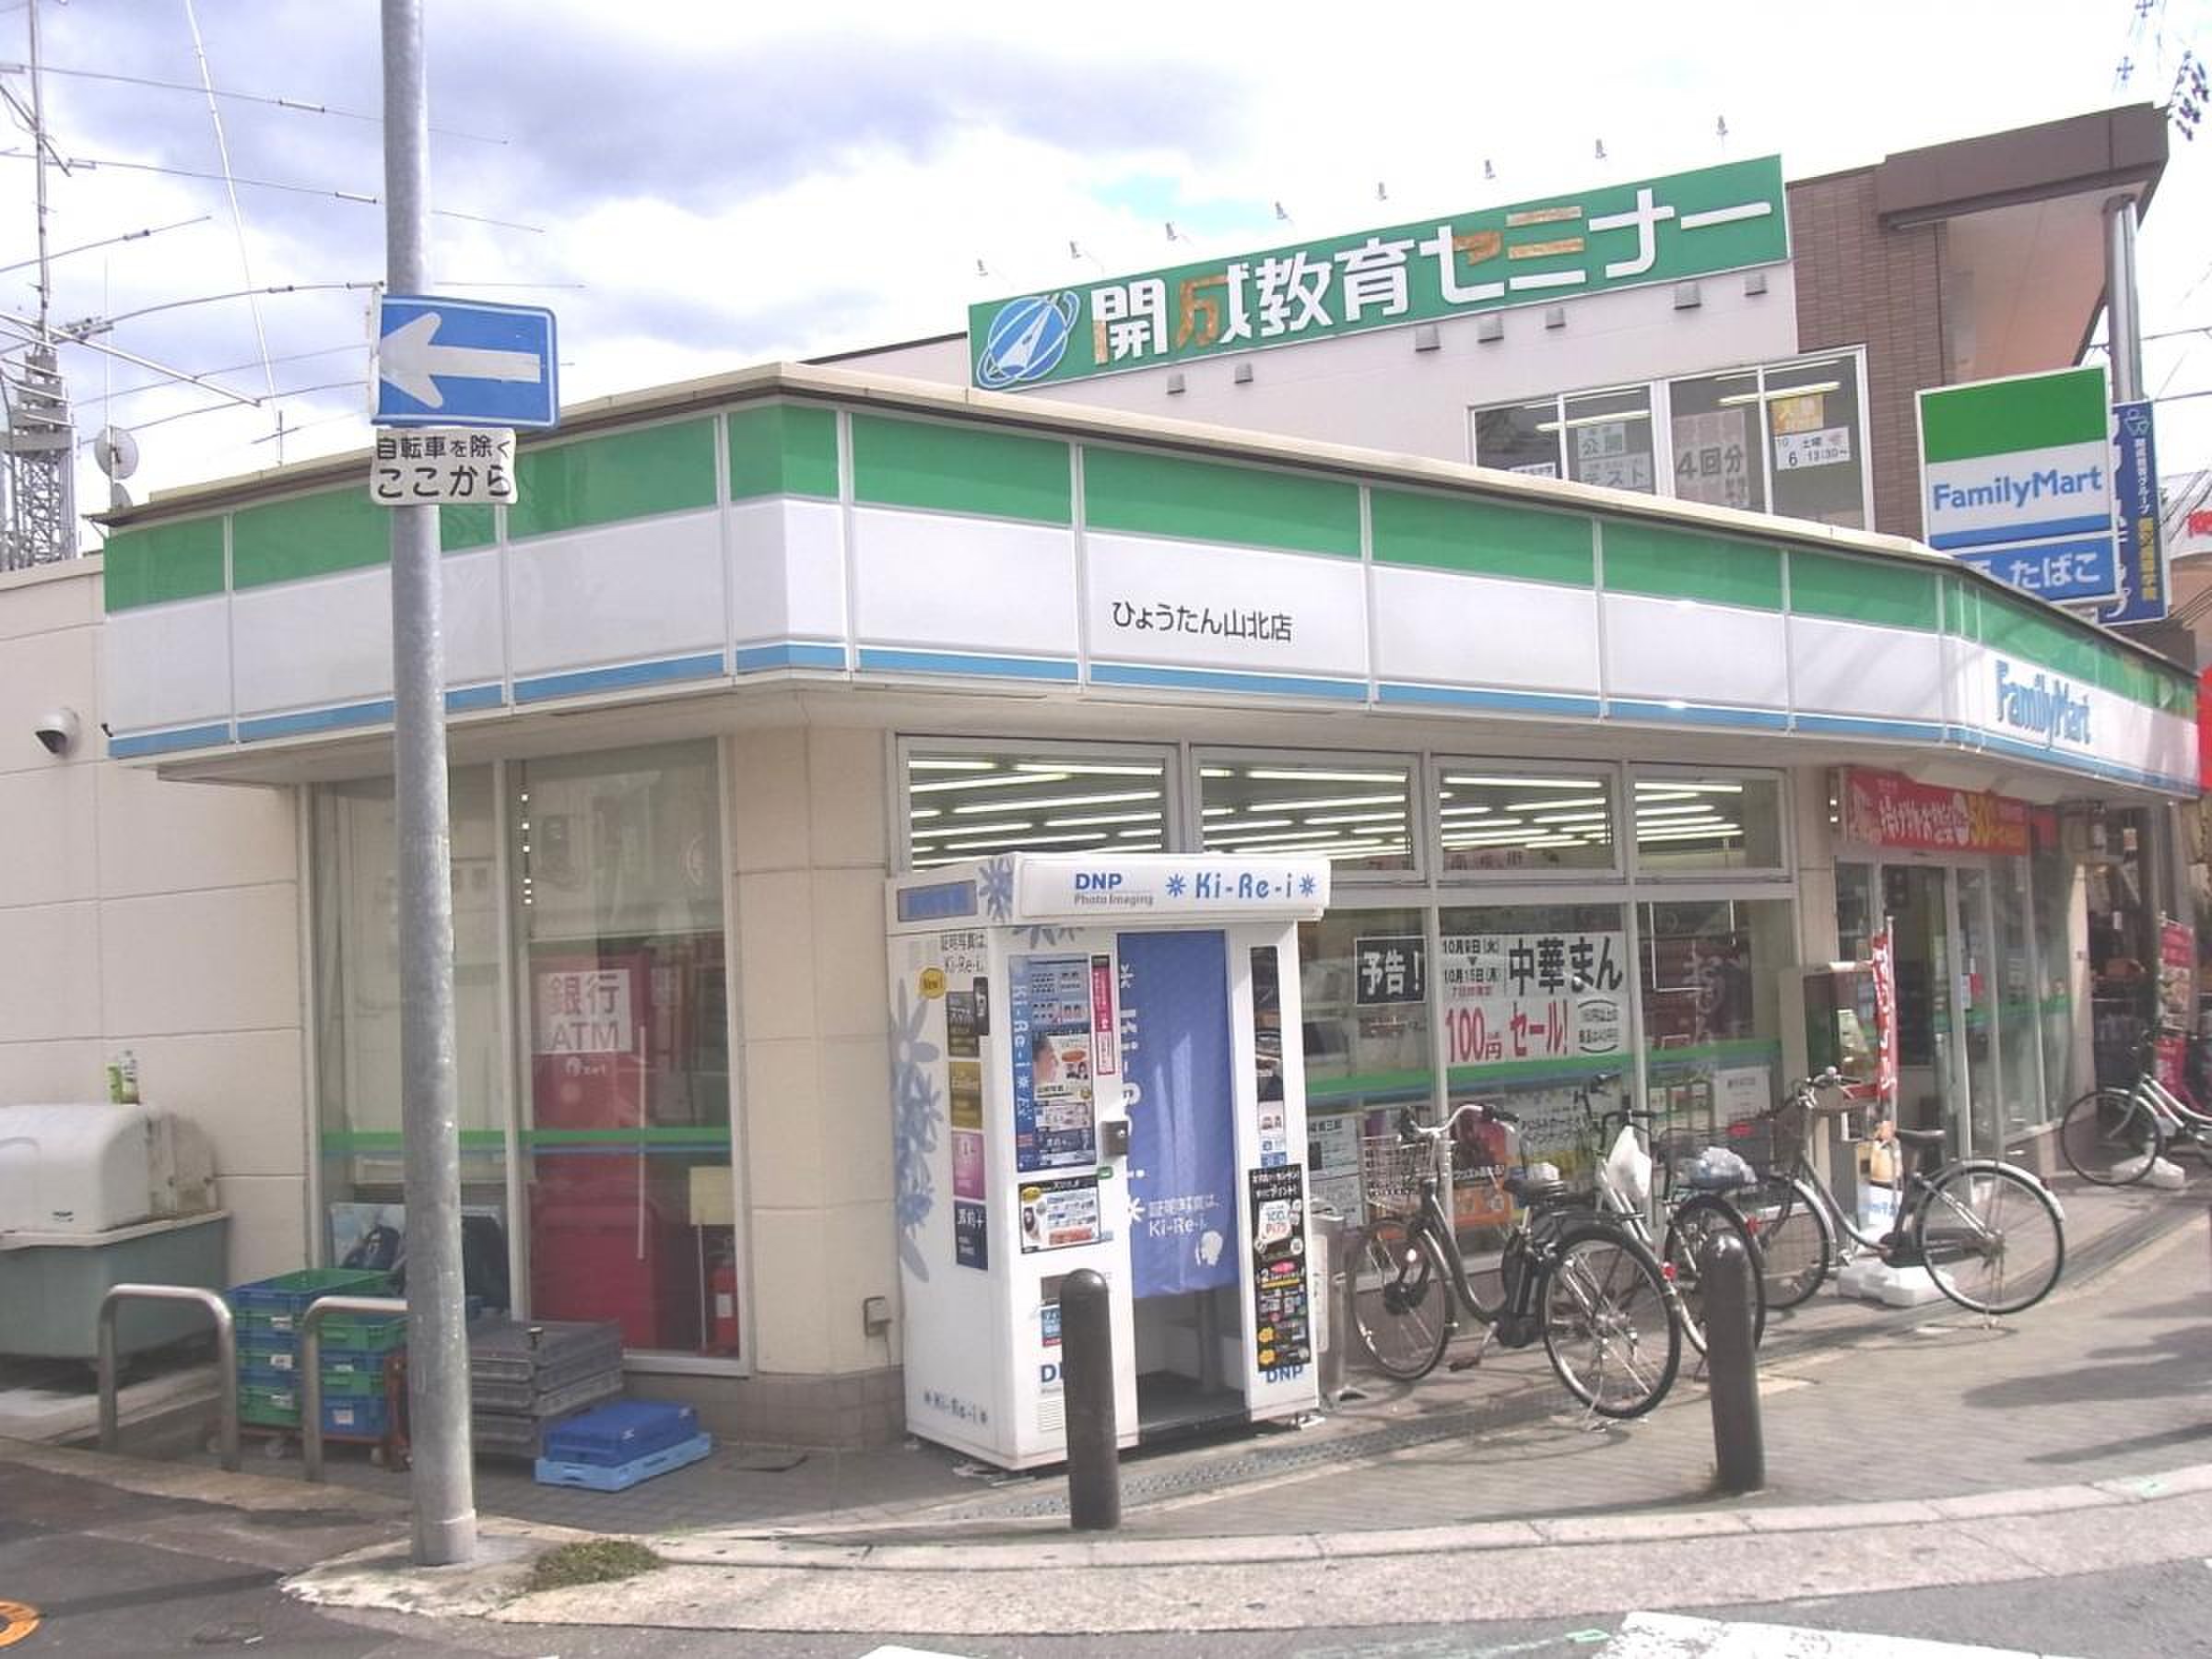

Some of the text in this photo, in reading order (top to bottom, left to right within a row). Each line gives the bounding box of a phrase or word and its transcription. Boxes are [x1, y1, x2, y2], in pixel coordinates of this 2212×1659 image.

[1091, 187, 1772, 365] 開成教育セミナー
[376, 434, 512, 460] 自転車を除く
[1677, 444, 1743, 480] 4回分
[1789, 451, 1798, 467] 6
[377, 464, 512, 499] ここから
[1932, 465, 2102, 511] FamilyMart
[2010, 552, 2101, 589] たばこ
[1112, 600, 1292, 642] ひょうたん山北店
[1994, 658, 2092, 750] FamilyMart
[1076, 873, 1123, 890] DNP
[1195, 872, 1292, 900] Ki-Re-i
[1075, 894, 1153, 907] Photo Imaging
[1361, 948, 1420, 995] 予告!
[1508, 935, 1623, 996] 中華まん
[546, 972, 620, 1016] 銀行
[547, 1019, 620, 1051] ATM
[1265, 1365, 1303, 1383] DNP
